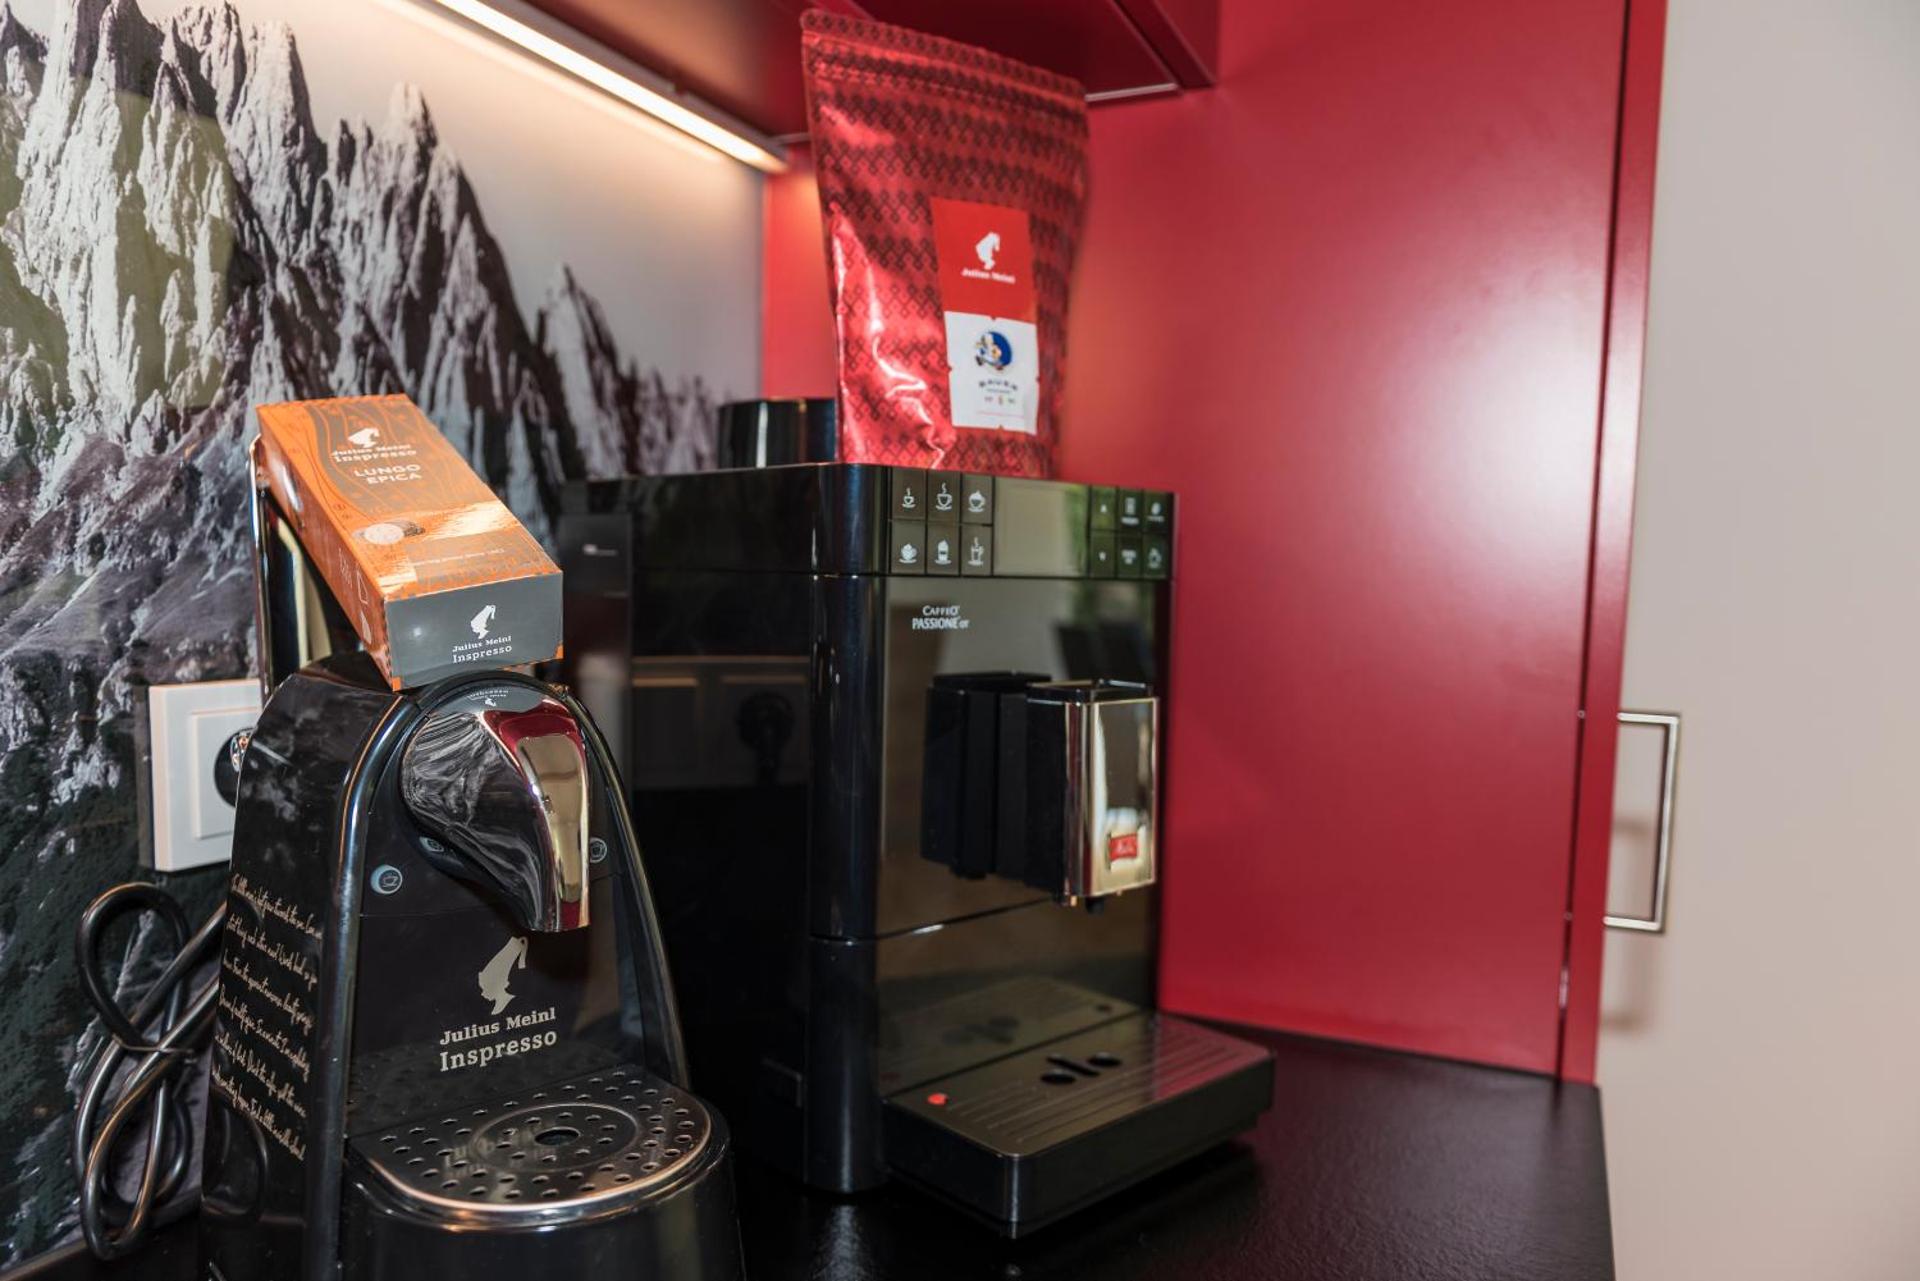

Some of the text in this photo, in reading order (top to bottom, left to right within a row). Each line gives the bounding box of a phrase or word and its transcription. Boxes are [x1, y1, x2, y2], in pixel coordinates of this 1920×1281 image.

[333, 449, 417, 463] Inspresso
[354, 464, 421, 477] LUNGO
[366, 472, 422, 485] EPICA
[452, 635, 512, 653] Julius Meinl
[452, 645, 513, 664] Inspresso
[440, 1007, 556, 1045] Julius Meinl
[440, 1031, 557, 1072] Inspresso
